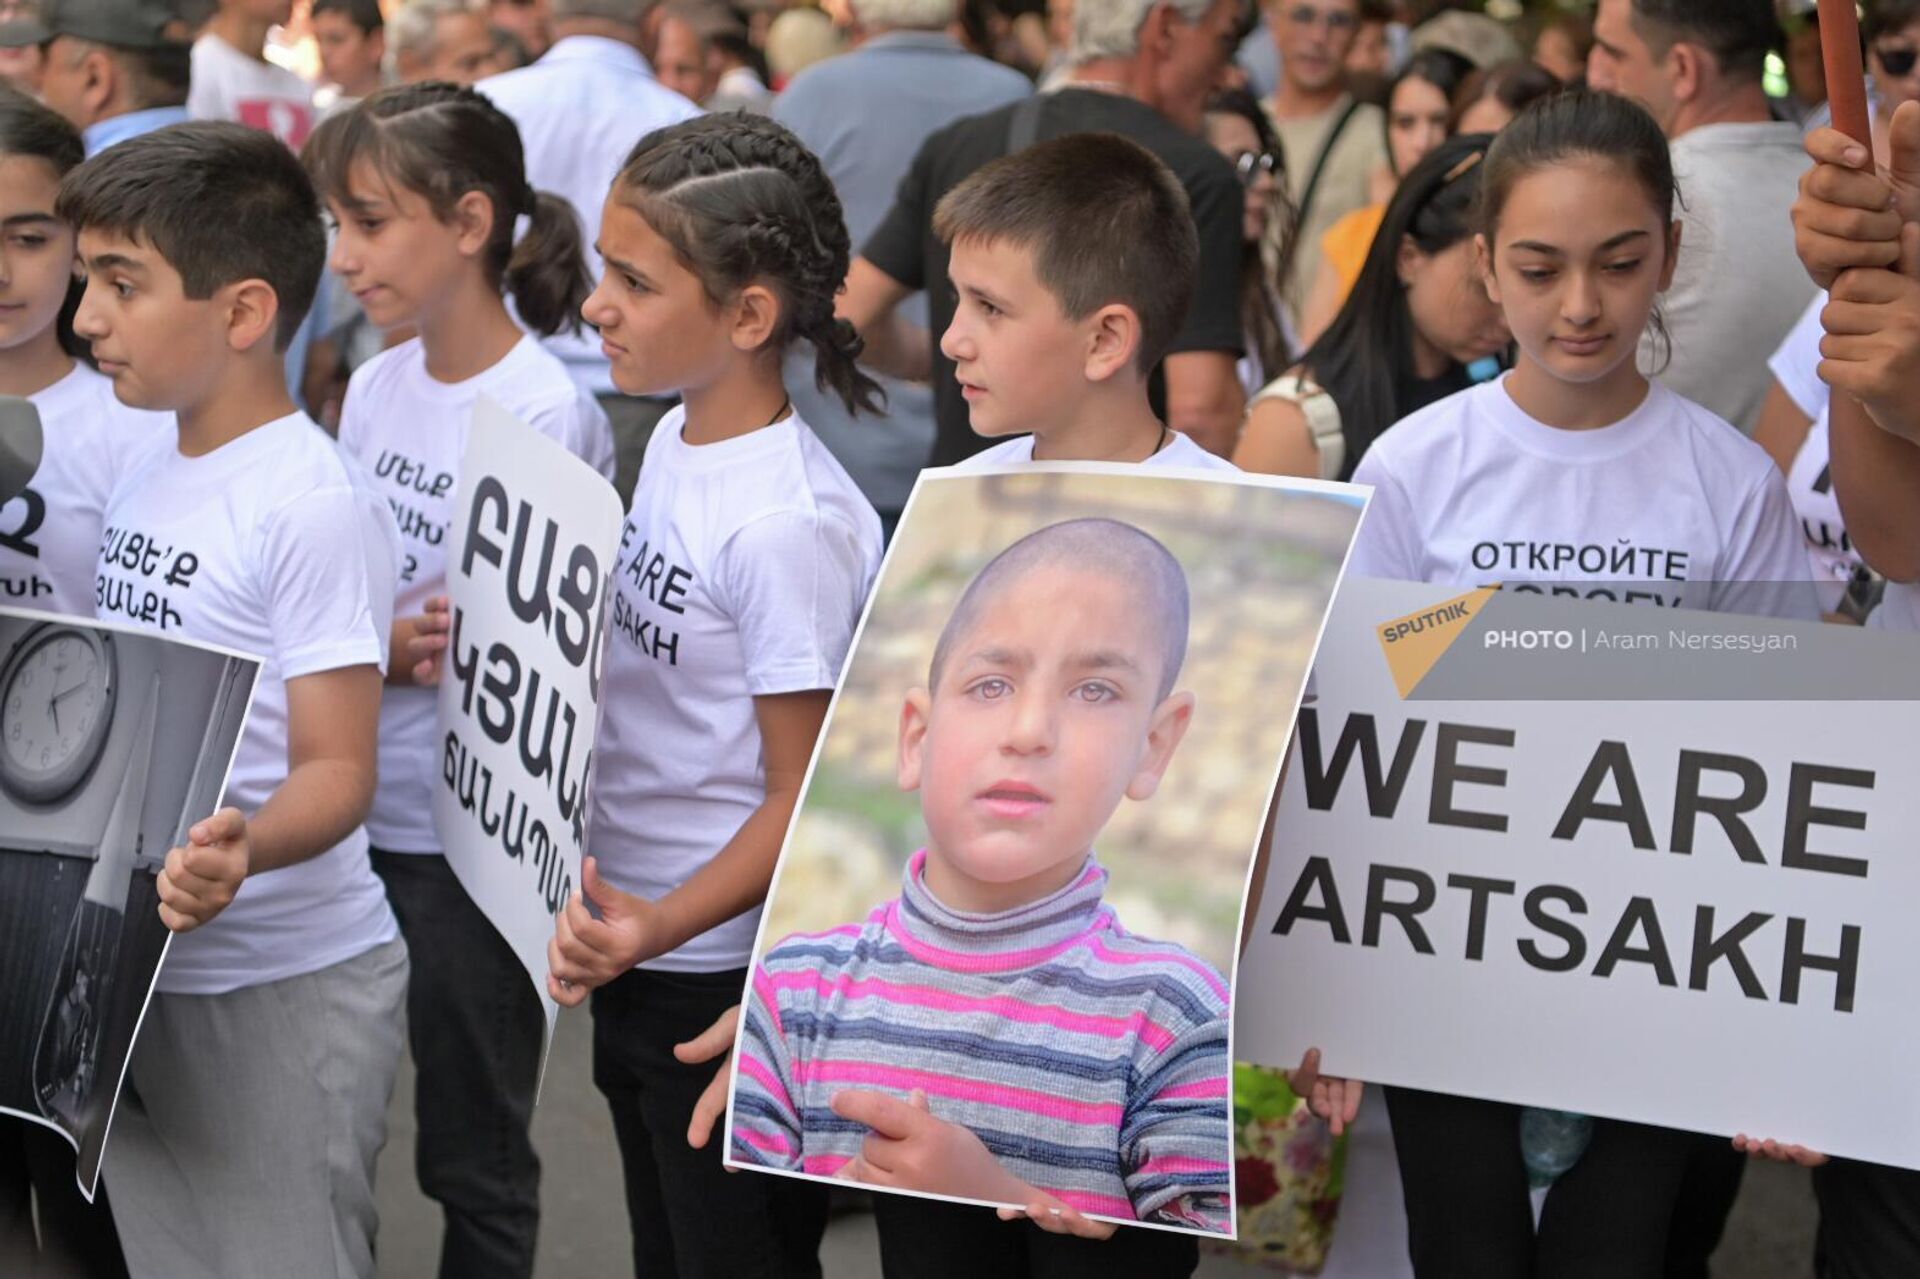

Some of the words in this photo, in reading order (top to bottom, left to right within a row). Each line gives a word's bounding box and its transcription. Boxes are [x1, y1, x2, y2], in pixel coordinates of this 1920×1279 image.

[626, 541, 693, 615] ARE
[1472, 538, 1689, 581] ОТКРОЙТЕ
[96, 574, 182, 630] ՅԱՆՔԻ
[614, 590, 679, 666] SAKH
[1298, 706, 1517, 833] WE
[1550, 740, 1876, 878] ARE
[1271, 855, 1862, 1014] ARTSAKH
